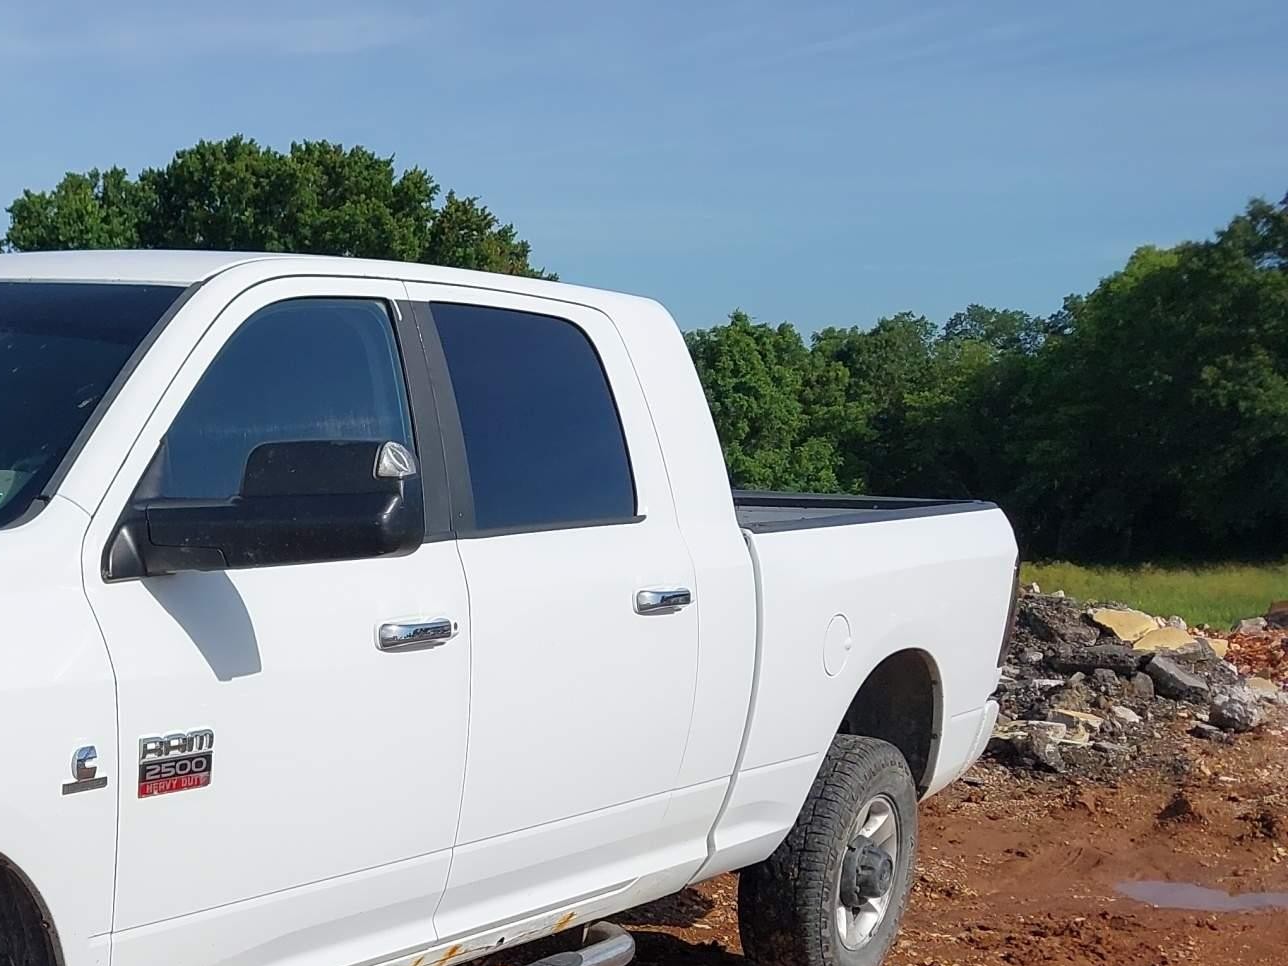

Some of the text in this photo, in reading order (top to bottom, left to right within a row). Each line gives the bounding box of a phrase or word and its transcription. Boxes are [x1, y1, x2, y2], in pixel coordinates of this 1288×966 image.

[139, 729, 214, 760] RAM
[145, 757, 207, 780] 2500
[145, 777, 178, 794] HEAVY
